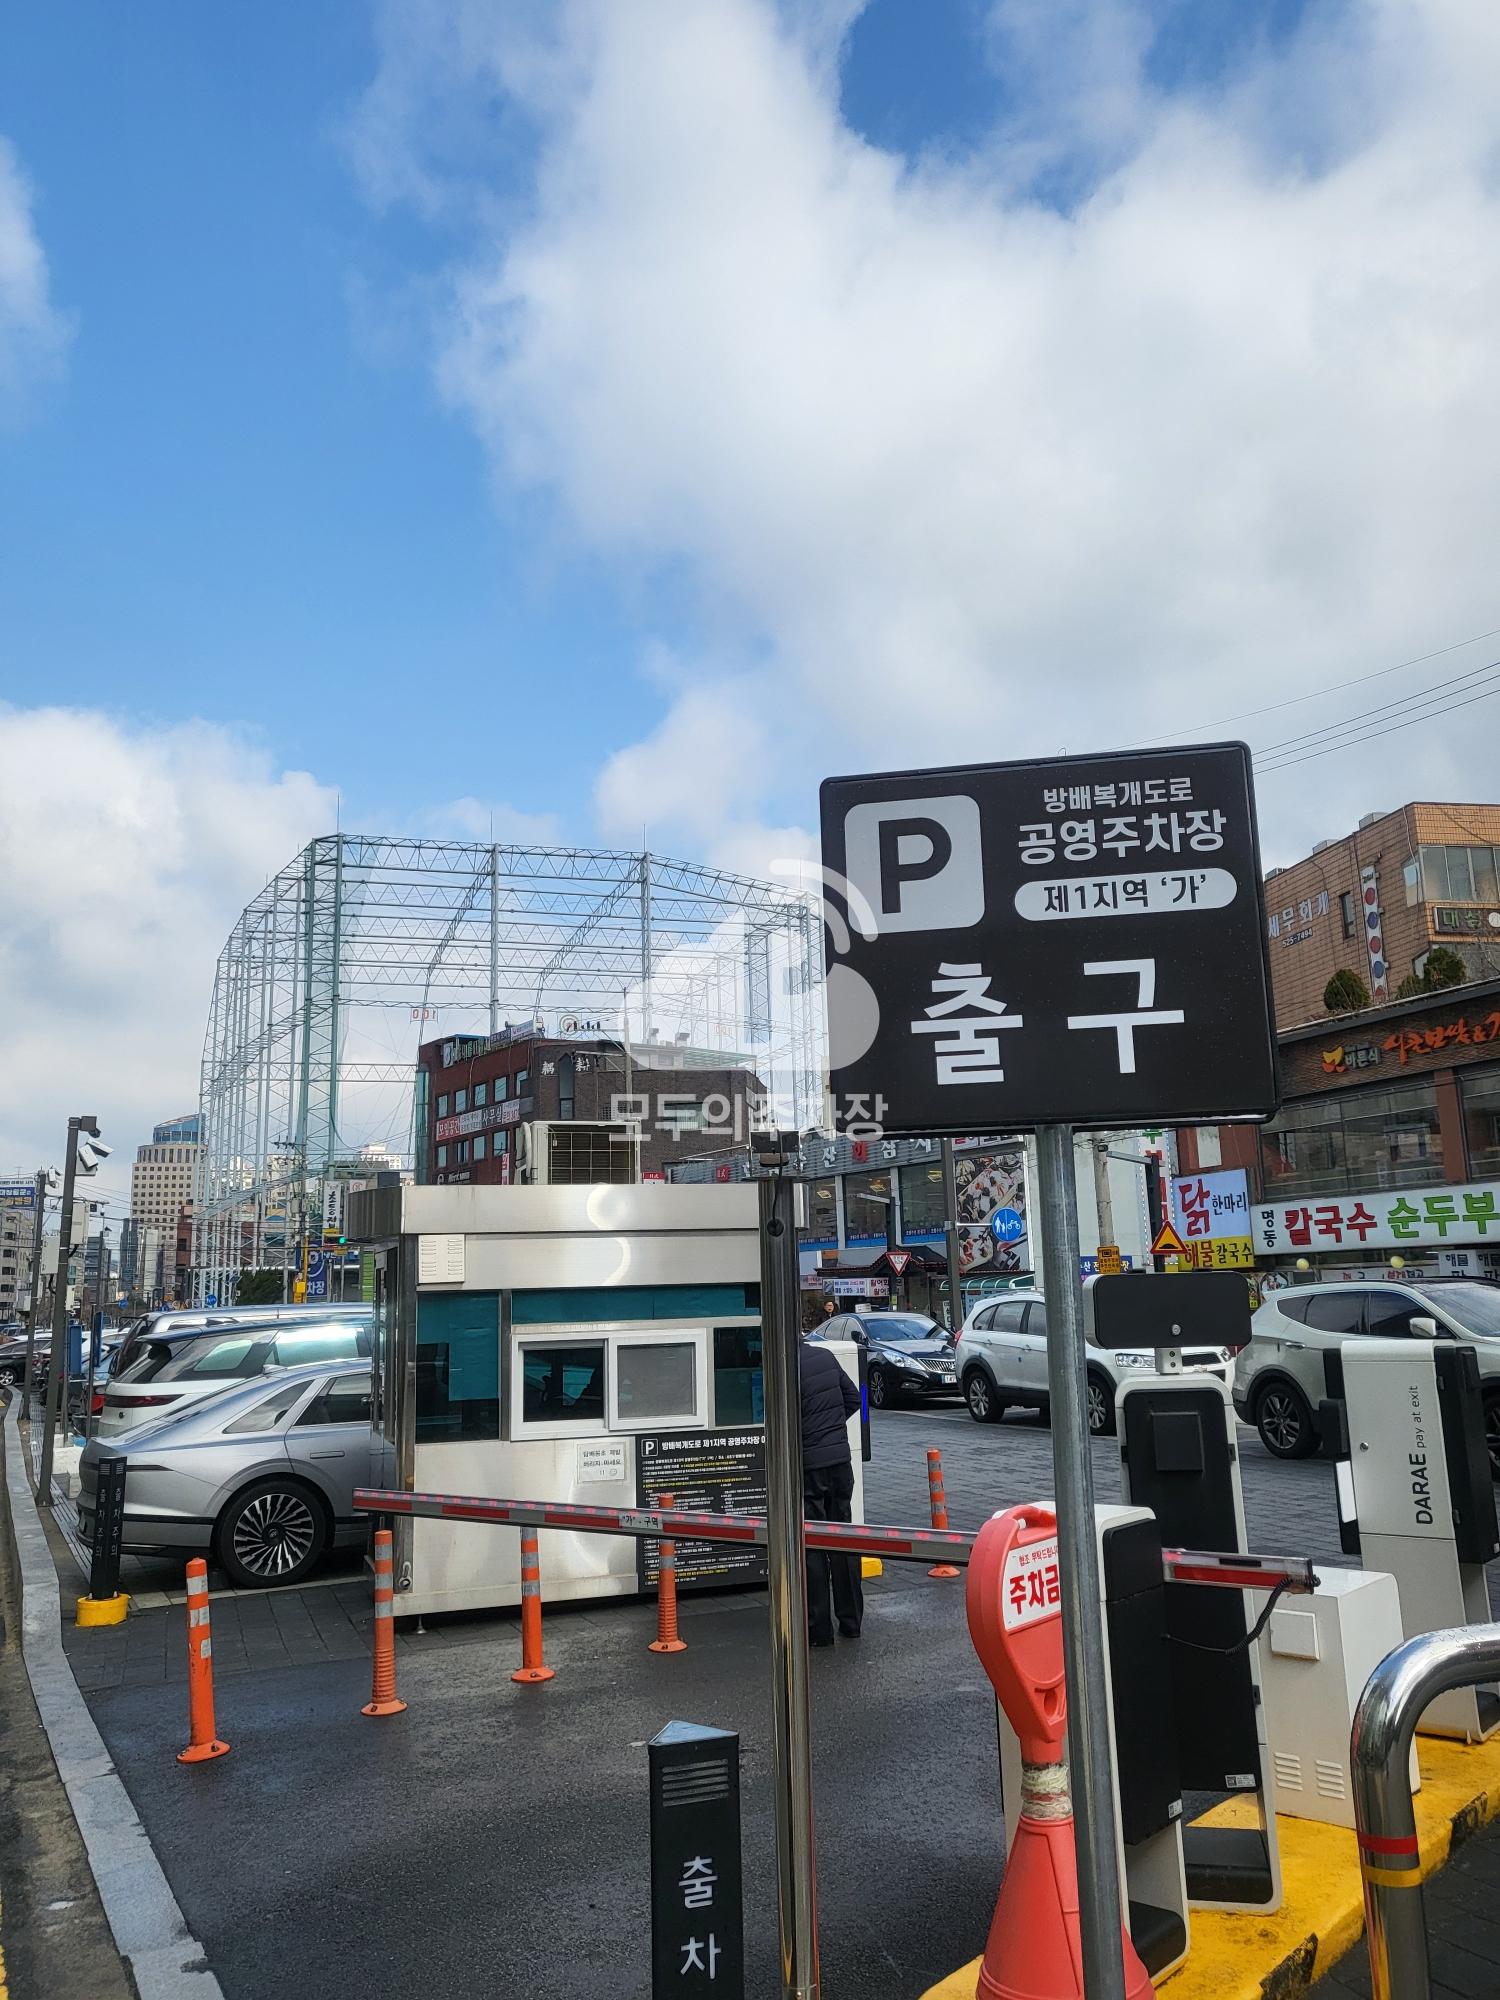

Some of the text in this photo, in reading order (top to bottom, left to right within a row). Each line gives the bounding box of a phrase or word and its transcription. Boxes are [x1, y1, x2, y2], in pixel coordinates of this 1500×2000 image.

[1043, 777, 1193, 813] 방배복개도로
[1017, 810, 1227, 865] 공영주차장
[879, 817, 952, 914] P
[1043, 879, 1149, 914] 제1지역
[1179, 1178, 1247, 1237] 닭 한마리
[1261, 1191, 1500, 1249] 명동 칼국수 순두부
[1408, 1385, 1433, 1524] DARAE pay at exit
[1031, 1545, 1058, 1562] 부탁드립니
[1009, 1563, 1060, 1616] 주차금
